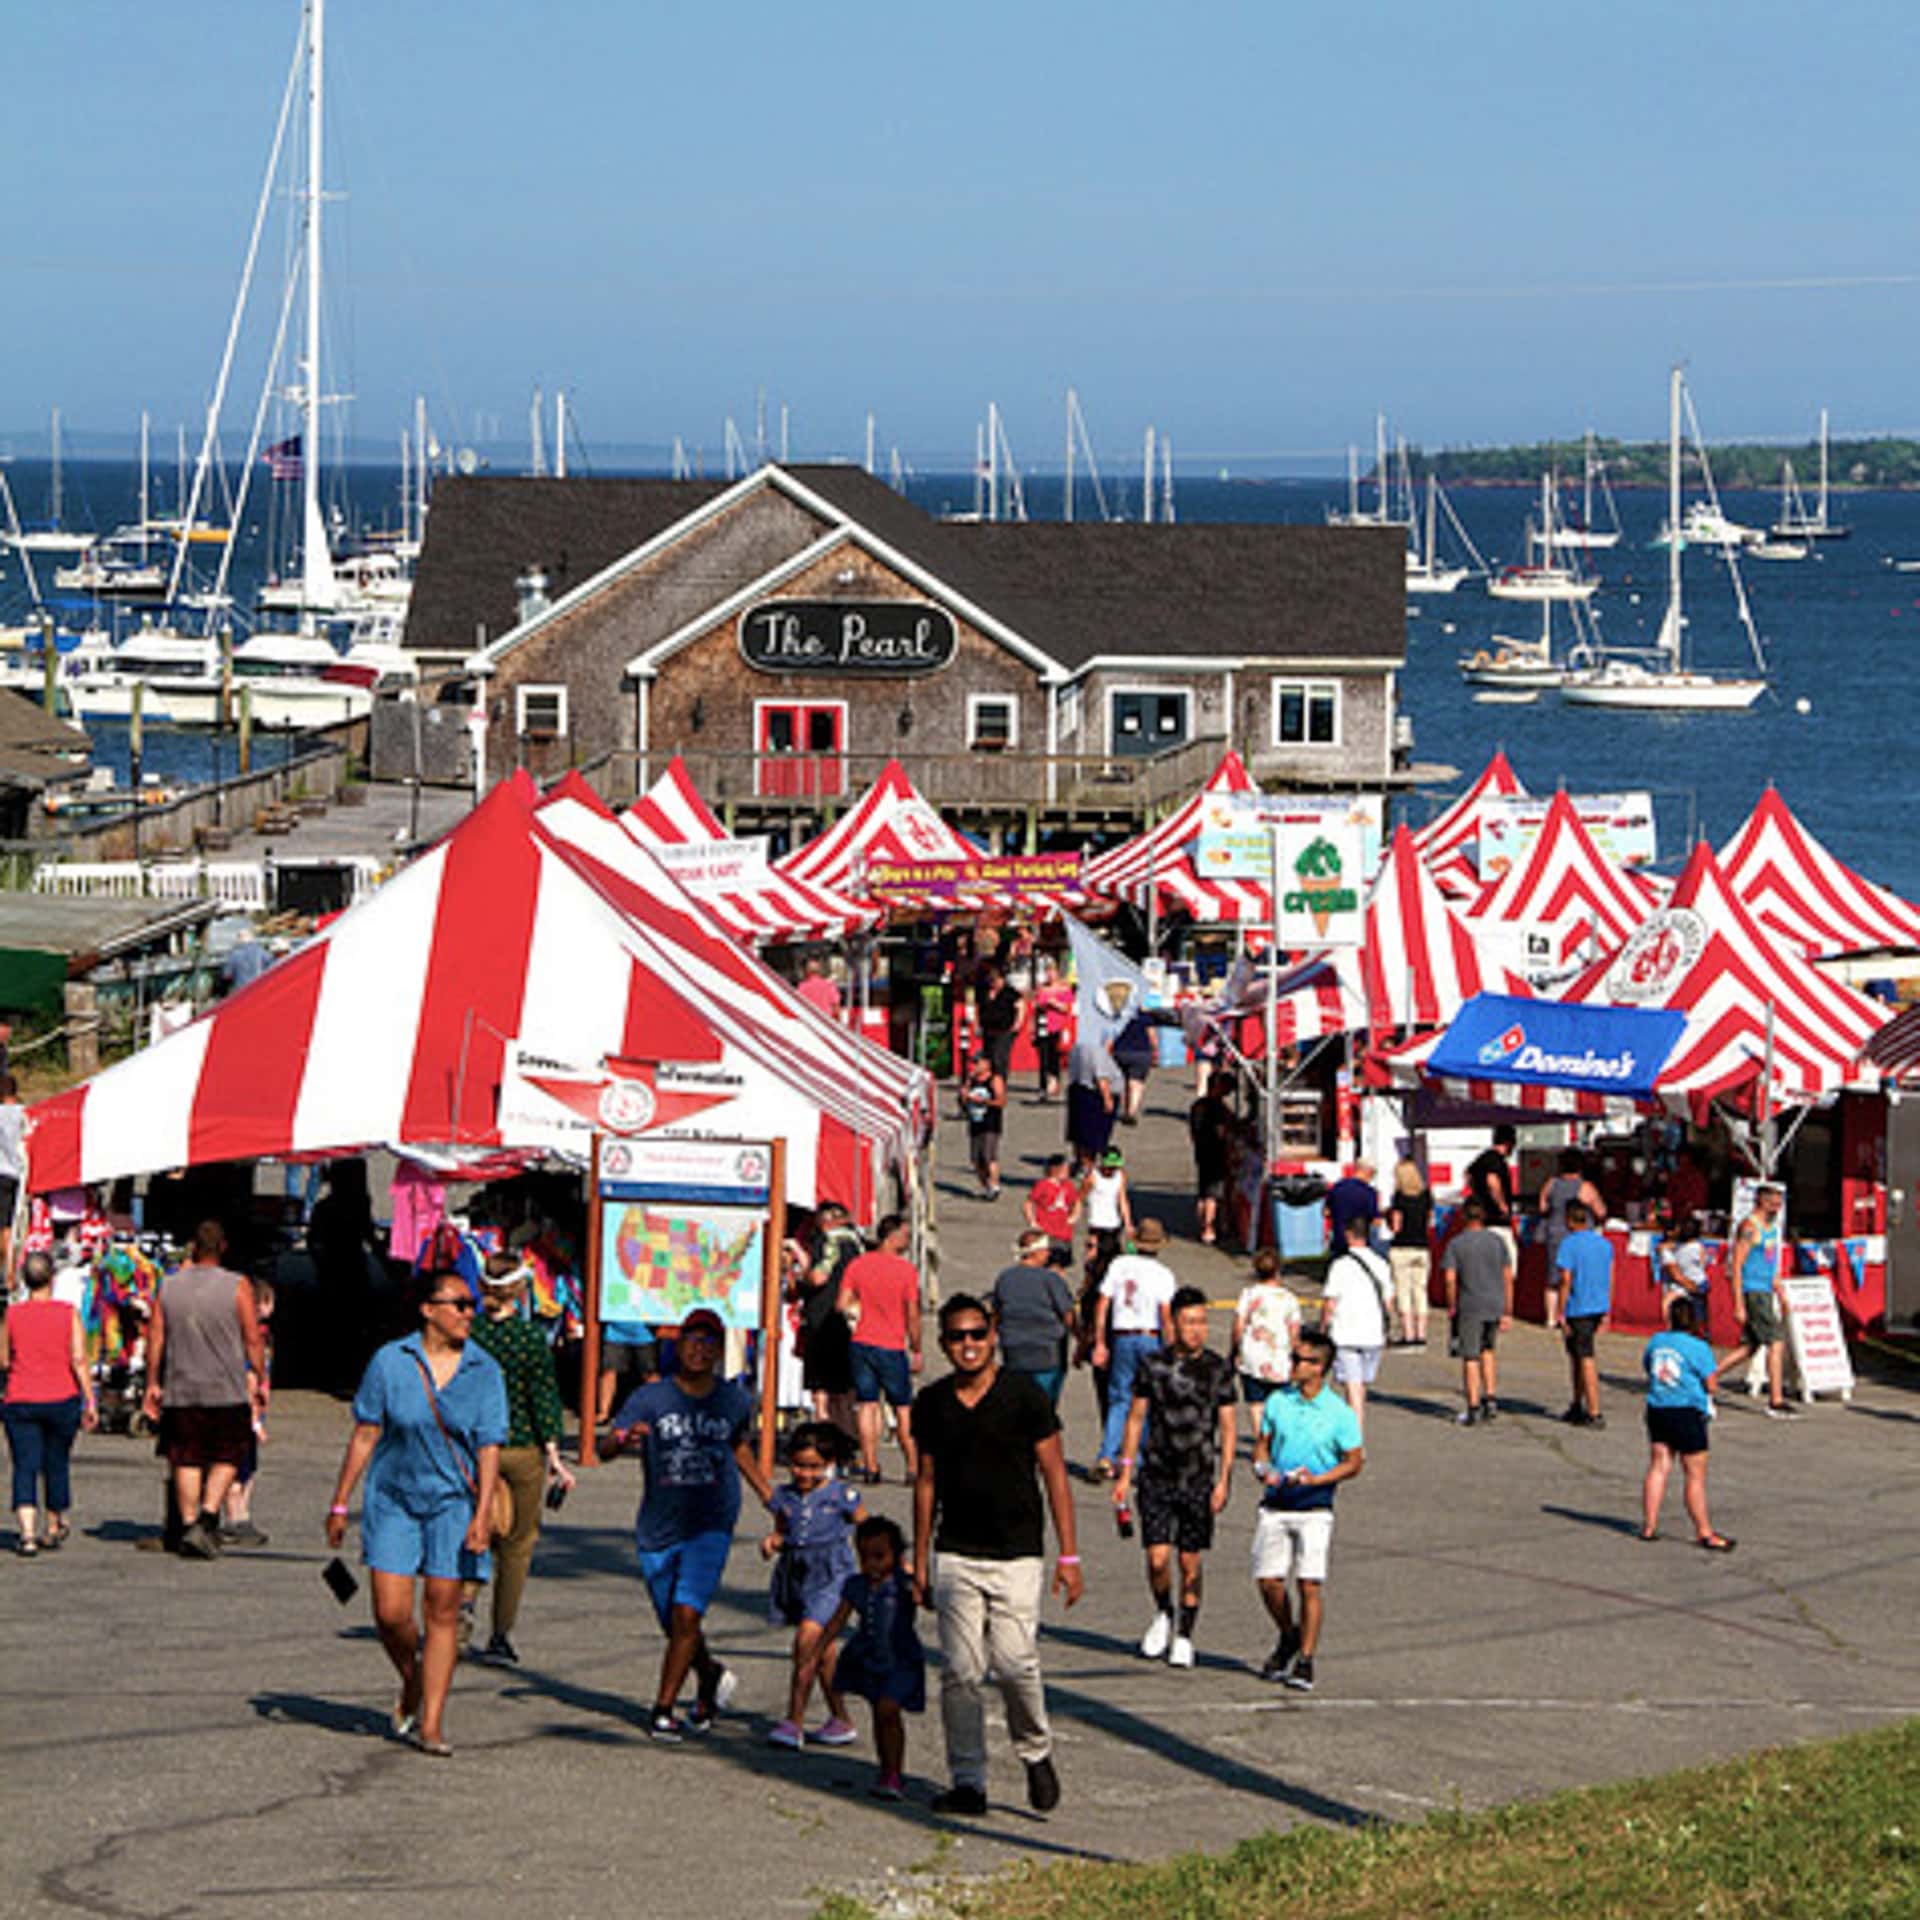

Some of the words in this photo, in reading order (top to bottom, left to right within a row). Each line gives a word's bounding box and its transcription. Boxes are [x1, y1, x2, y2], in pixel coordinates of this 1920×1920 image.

[754, 611, 825, 655] The
[837, 613, 939, 664] Pearl
[1283, 888, 1358, 914] cream
[1511, 1046, 1635, 1079] Domino's
